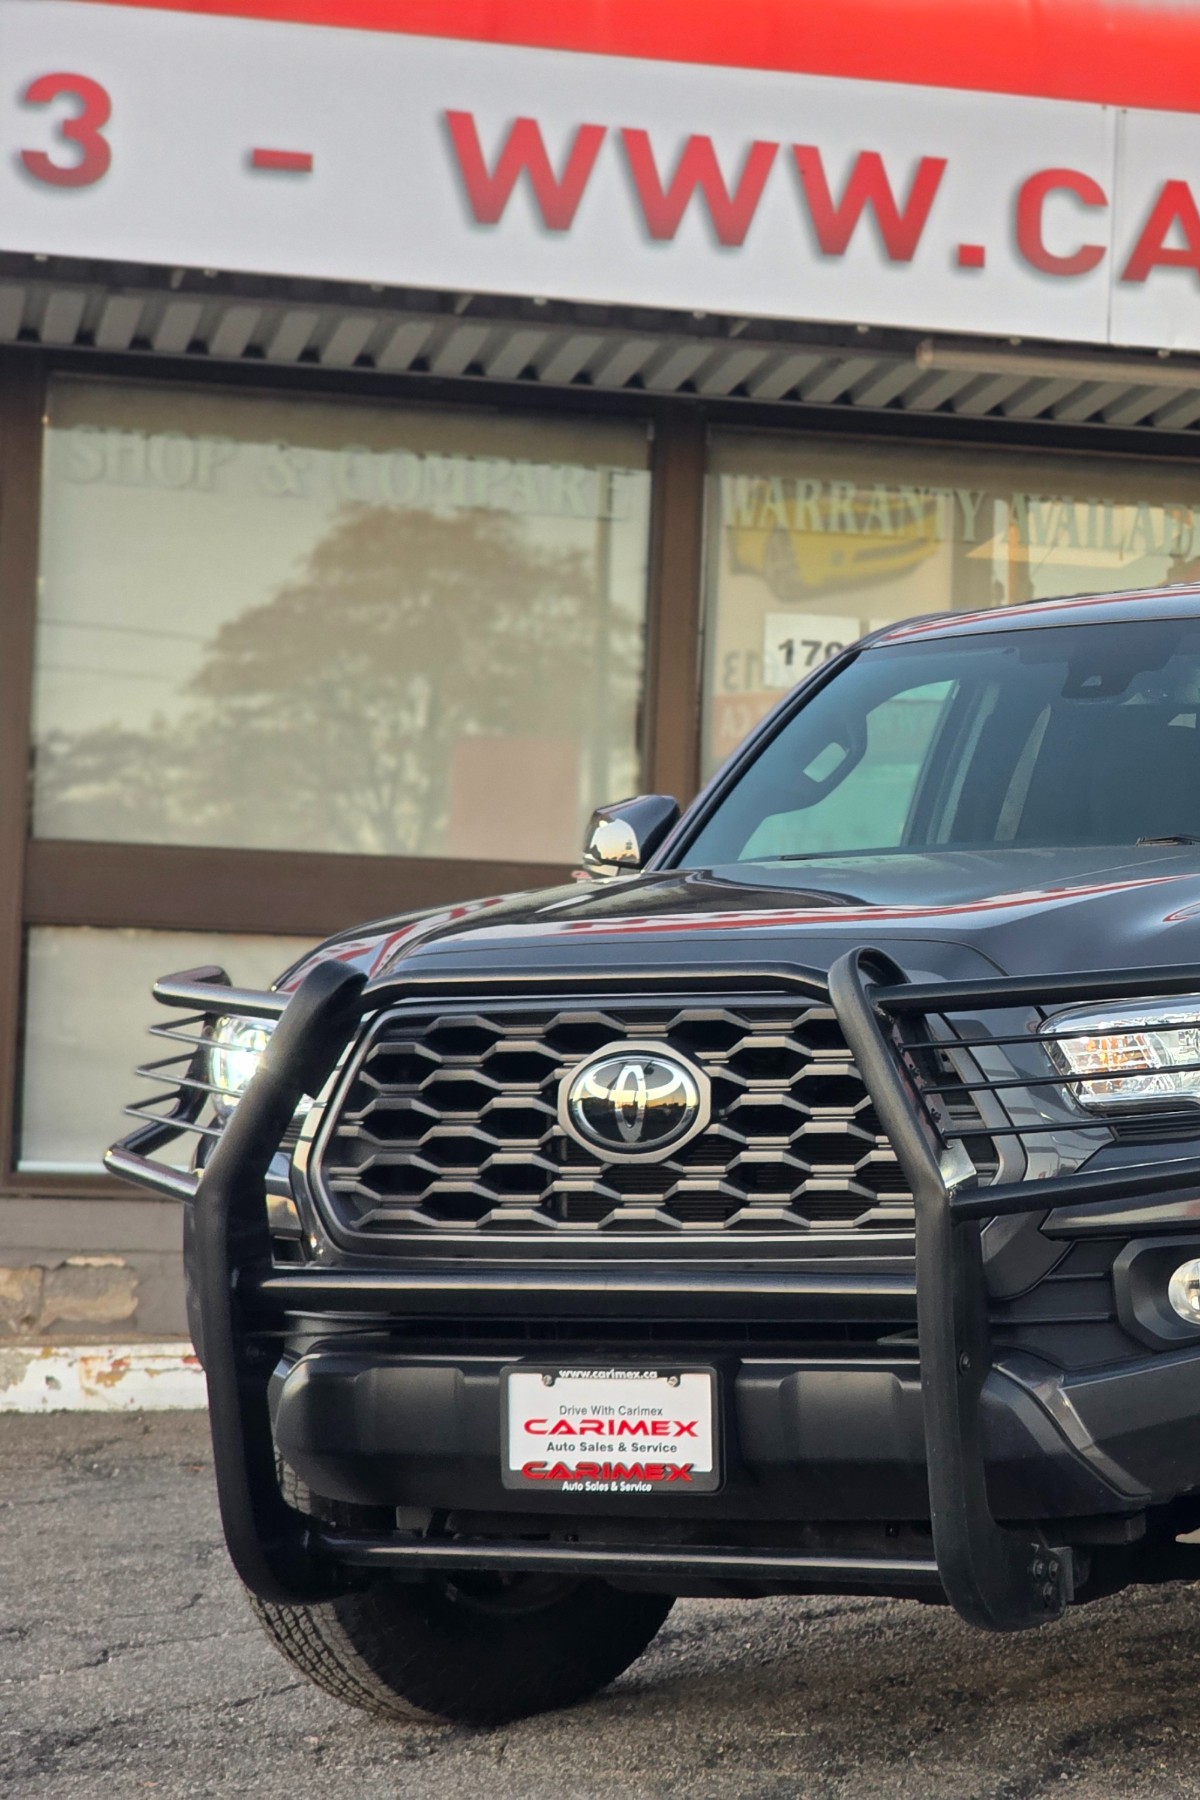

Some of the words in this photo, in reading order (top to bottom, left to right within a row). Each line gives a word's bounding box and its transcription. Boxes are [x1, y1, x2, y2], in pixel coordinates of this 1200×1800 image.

[19, 72, 113, 188] 3
[719, 473, 988, 542] WARRANTY
[558, 1368, 658, 1380] www.carimex.ca
[559, 1405, 588, 1416] Drive
[590, 1405, 615, 1416] With
[618, 1405, 663, 1416] Carimex
[523, 1418, 699, 1437] CARIMEX
[547, 1442, 576, 1452] Auto
[580, 1442, 614, 1453] Sales
[618, 1442, 627, 1452] &
[631, 1442, 678, 1453] Service
[521, 1461, 694, 1481] CARIMEX
[562, 1481, 584, 1492] Auto
[585, 1481, 610, 1492] Sales
[610, 1481, 618, 1492] &
[620, 1481, 652, 1492] Service
